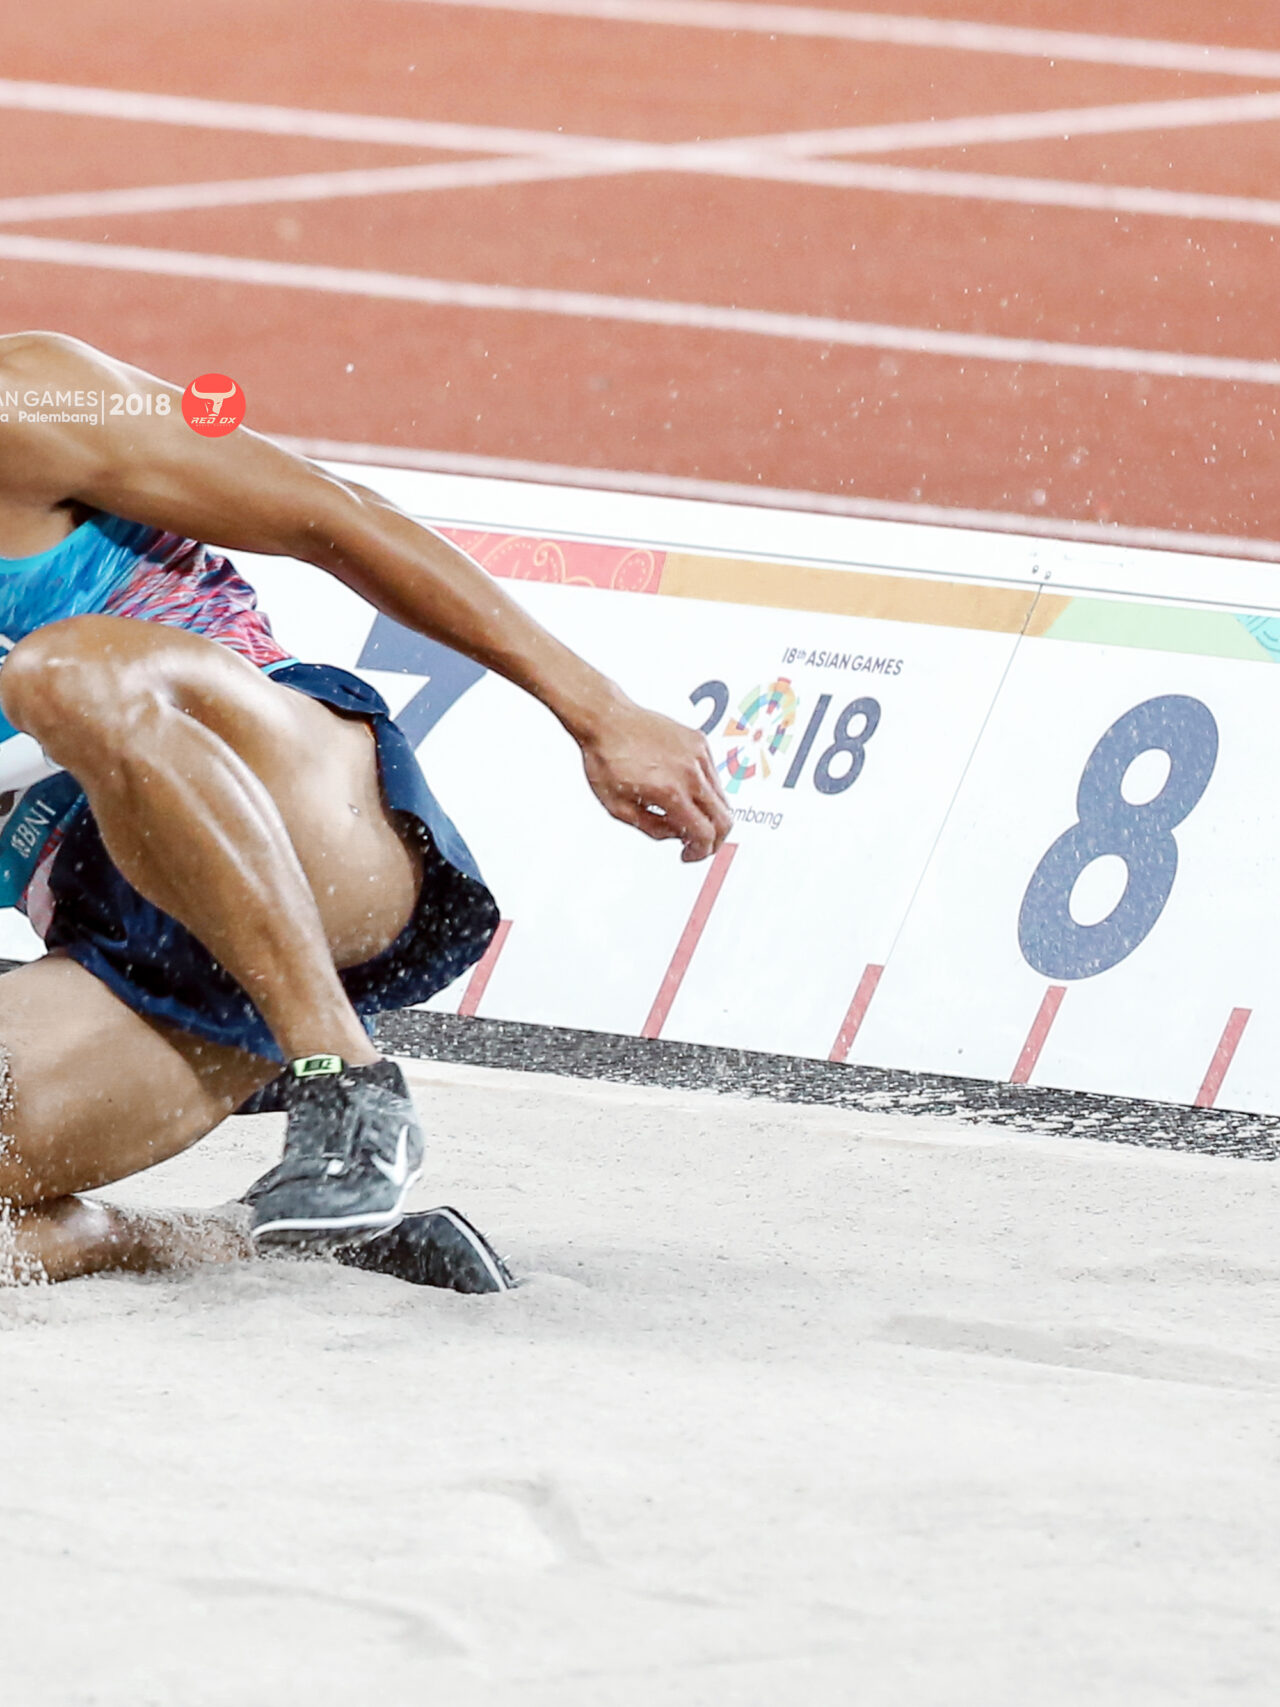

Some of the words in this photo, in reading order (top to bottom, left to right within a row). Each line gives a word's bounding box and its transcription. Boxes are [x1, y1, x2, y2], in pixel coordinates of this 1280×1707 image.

[804, 649, 851, 670] ASIAN
[851, 654, 904, 676] GAMES
[1017, 693, 1219, 981] 8
